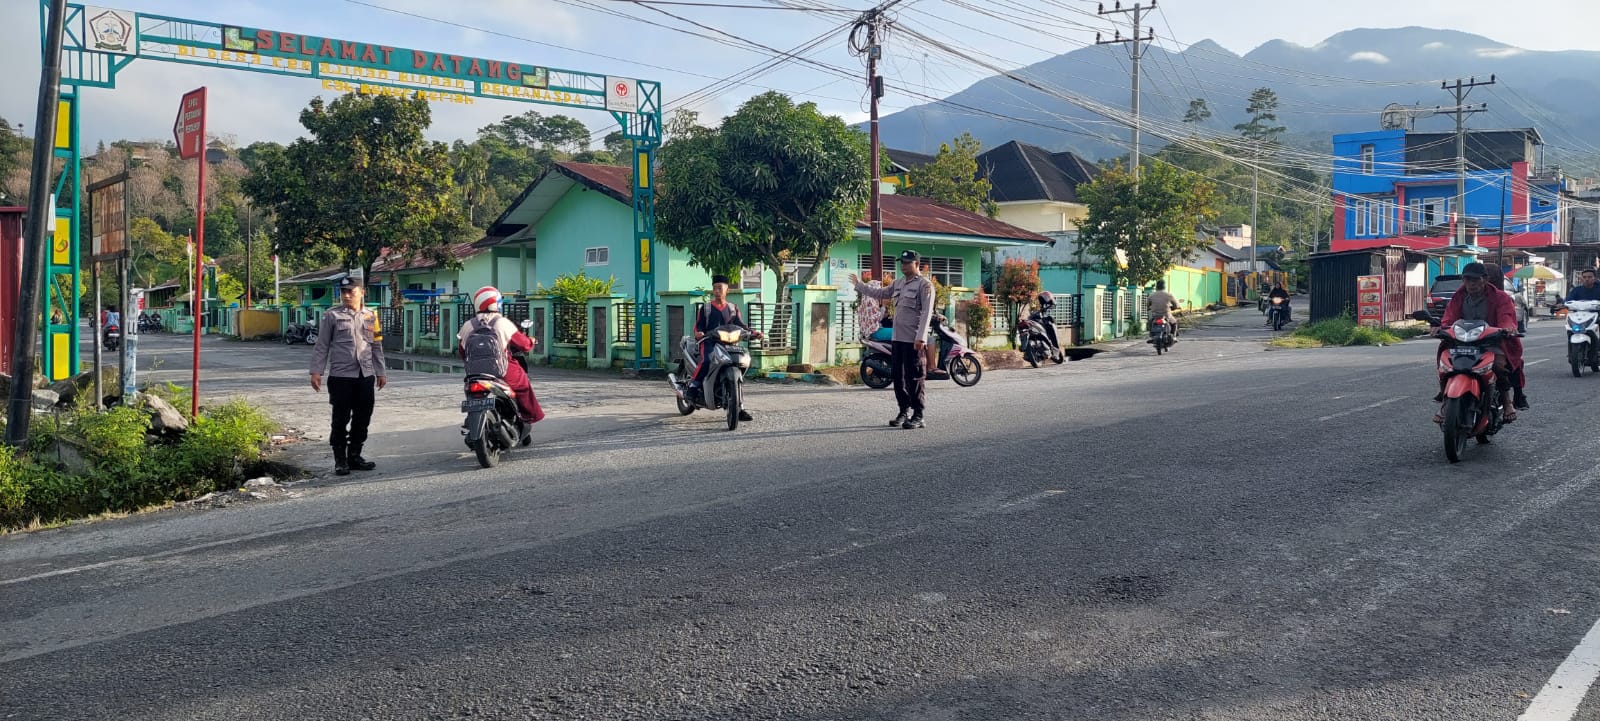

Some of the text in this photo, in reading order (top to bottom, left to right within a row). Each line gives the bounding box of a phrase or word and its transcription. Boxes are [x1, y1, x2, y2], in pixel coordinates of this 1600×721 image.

[256, 29, 521, 81] SELAMAT DATANG
[482, 81, 583, 105] DEKRANASDA
